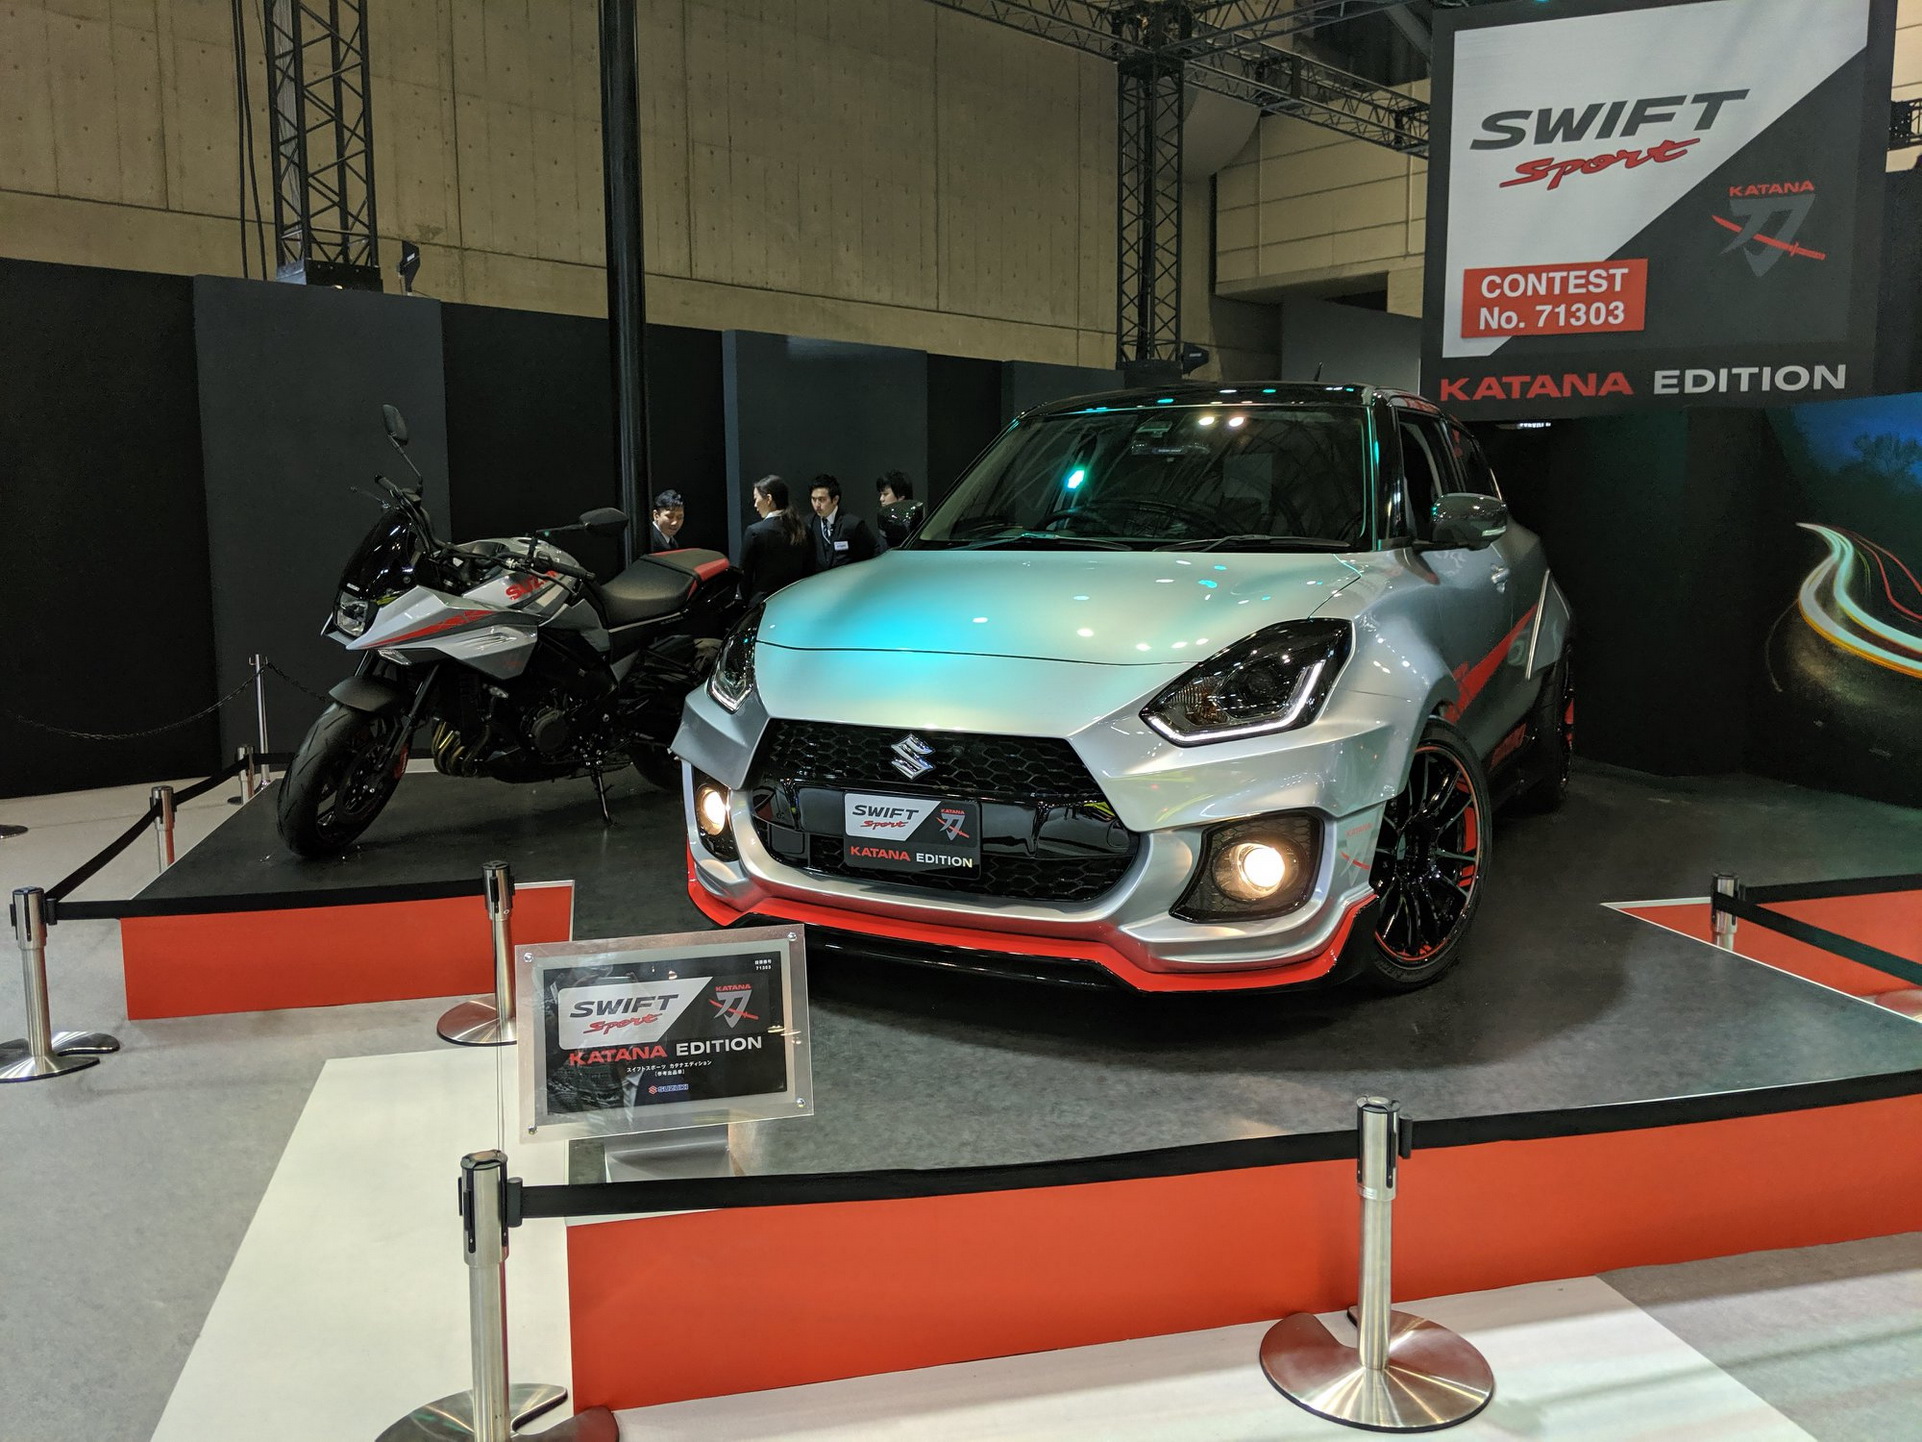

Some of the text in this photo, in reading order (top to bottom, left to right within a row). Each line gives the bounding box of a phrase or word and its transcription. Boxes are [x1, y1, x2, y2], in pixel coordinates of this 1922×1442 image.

[1469, 88, 1750, 150] SWIFT
[1500, 138, 1700, 190] Sport
[1729, 180, 1815, 197] KATANA
[1481, 268, 1628, 298] CONTEST
[1478, 301, 1625, 330] No. 71303
[1441, 364, 1846, 401] KATANA EDITION
[852, 804, 919, 820] SWIFT
[860, 820, 909, 830] Sport
[850, 845, 973, 868] KATANA EDITION
[715, 984, 751, 992] KATANA
[569, 993, 679, 1018] SWIFT
[583, 1013, 663, 1035] Sport
[569, 1036, 762, 1066] KATANA EDITION
